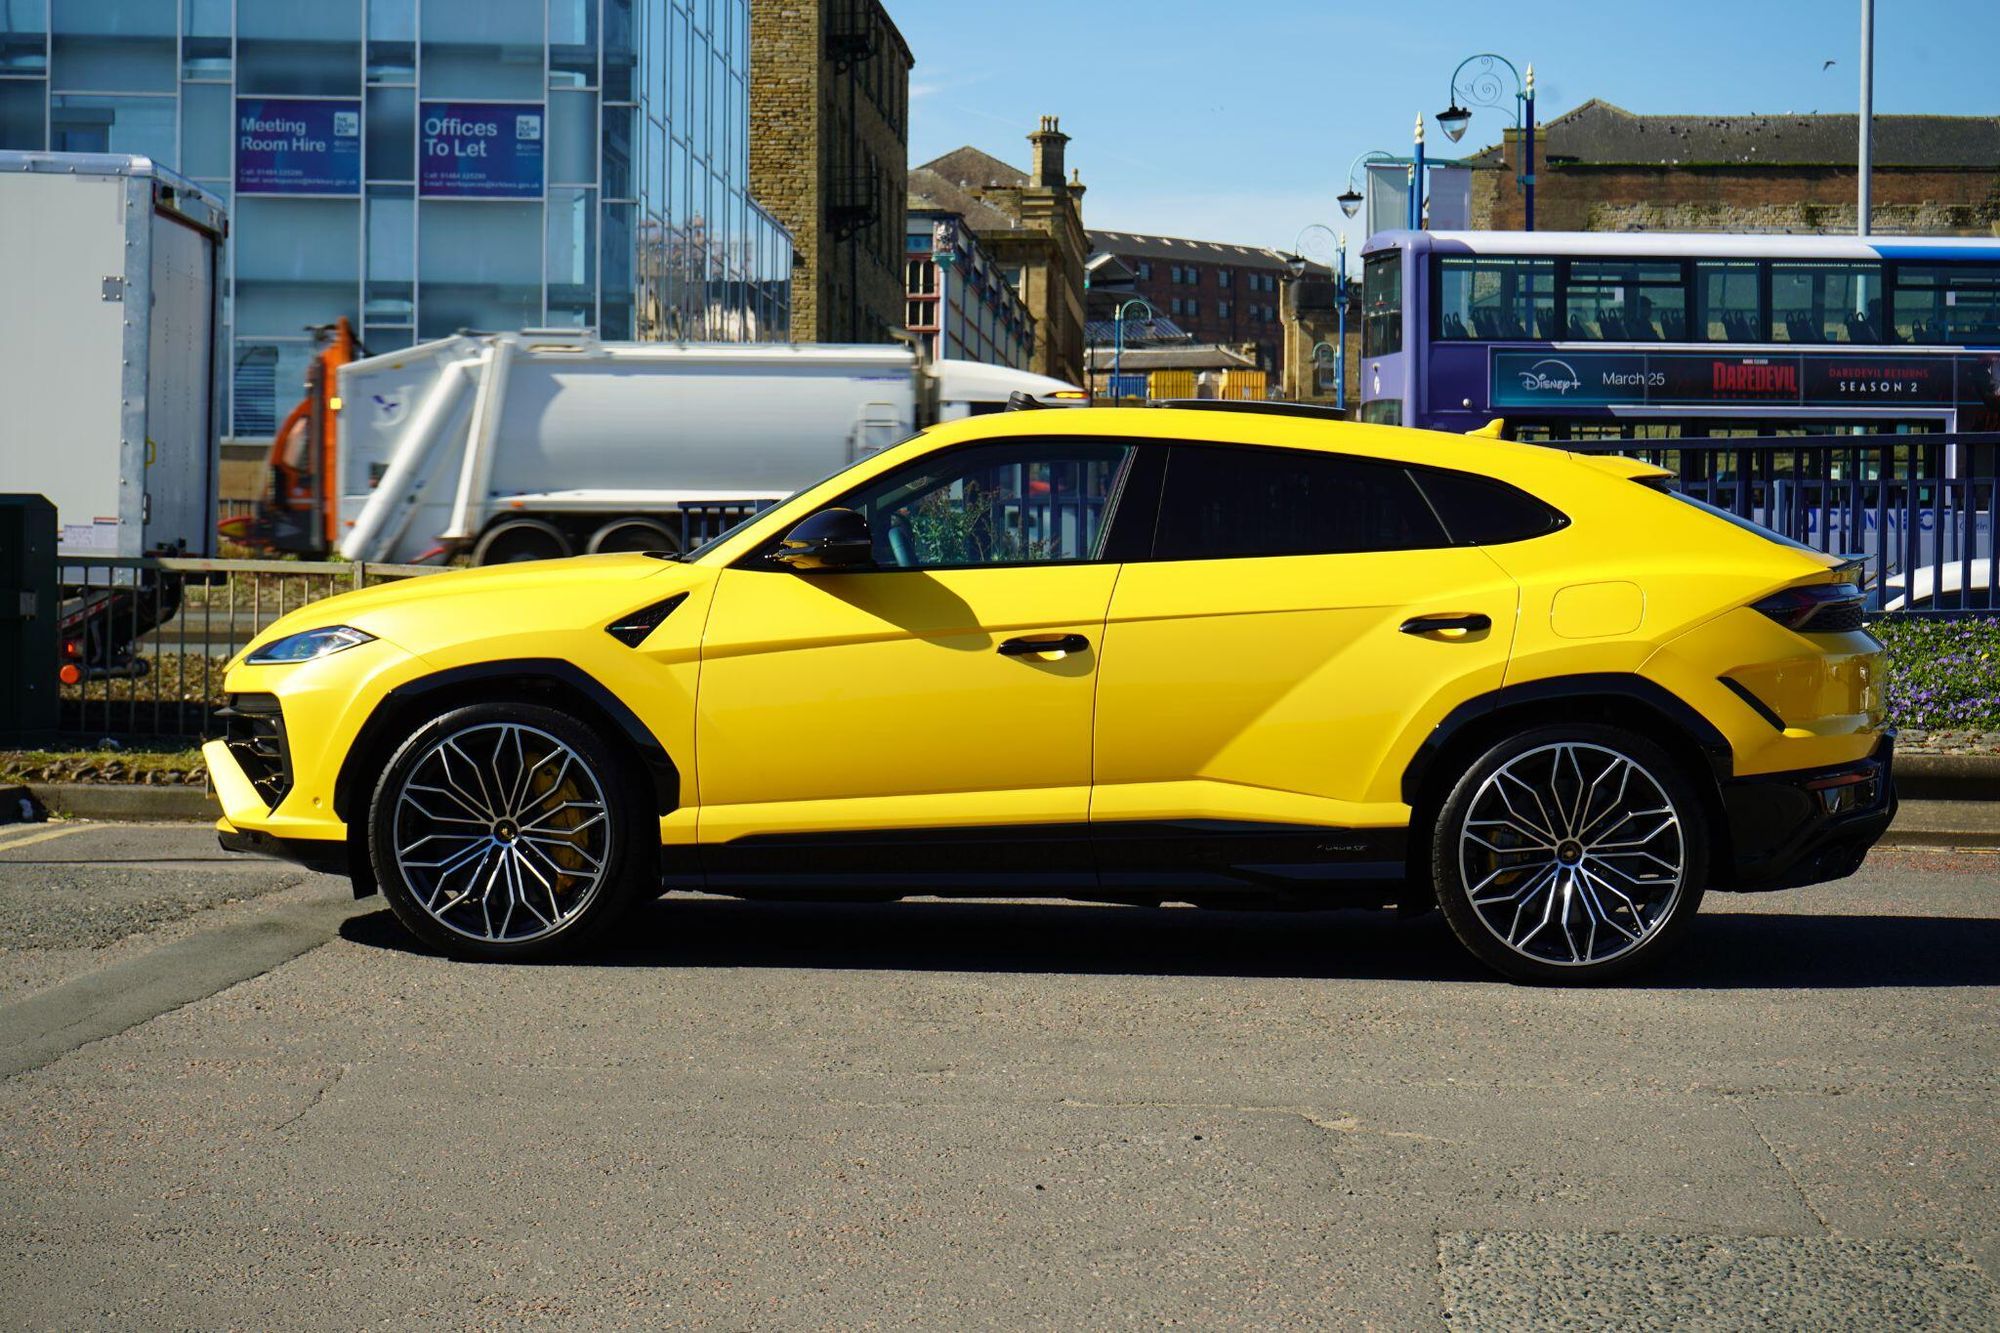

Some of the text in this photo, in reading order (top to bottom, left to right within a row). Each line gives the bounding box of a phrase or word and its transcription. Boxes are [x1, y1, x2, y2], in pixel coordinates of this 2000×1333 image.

[241, 117, 306, 135] Meeting
[424, 117, 498, 137] Offices
[241, 136, 288, 151] Room
[292, 136, 326, 152] Hire
[424, 138, 487, 157] To Let
[1602, 372, 1665, 386] March 25
[1712, 361, 1798, 393] DAREDEVIL
[1828, 367, 1881, 378] DAREDEVIL
[1839, 381, 1918, 392] SEASON 2
